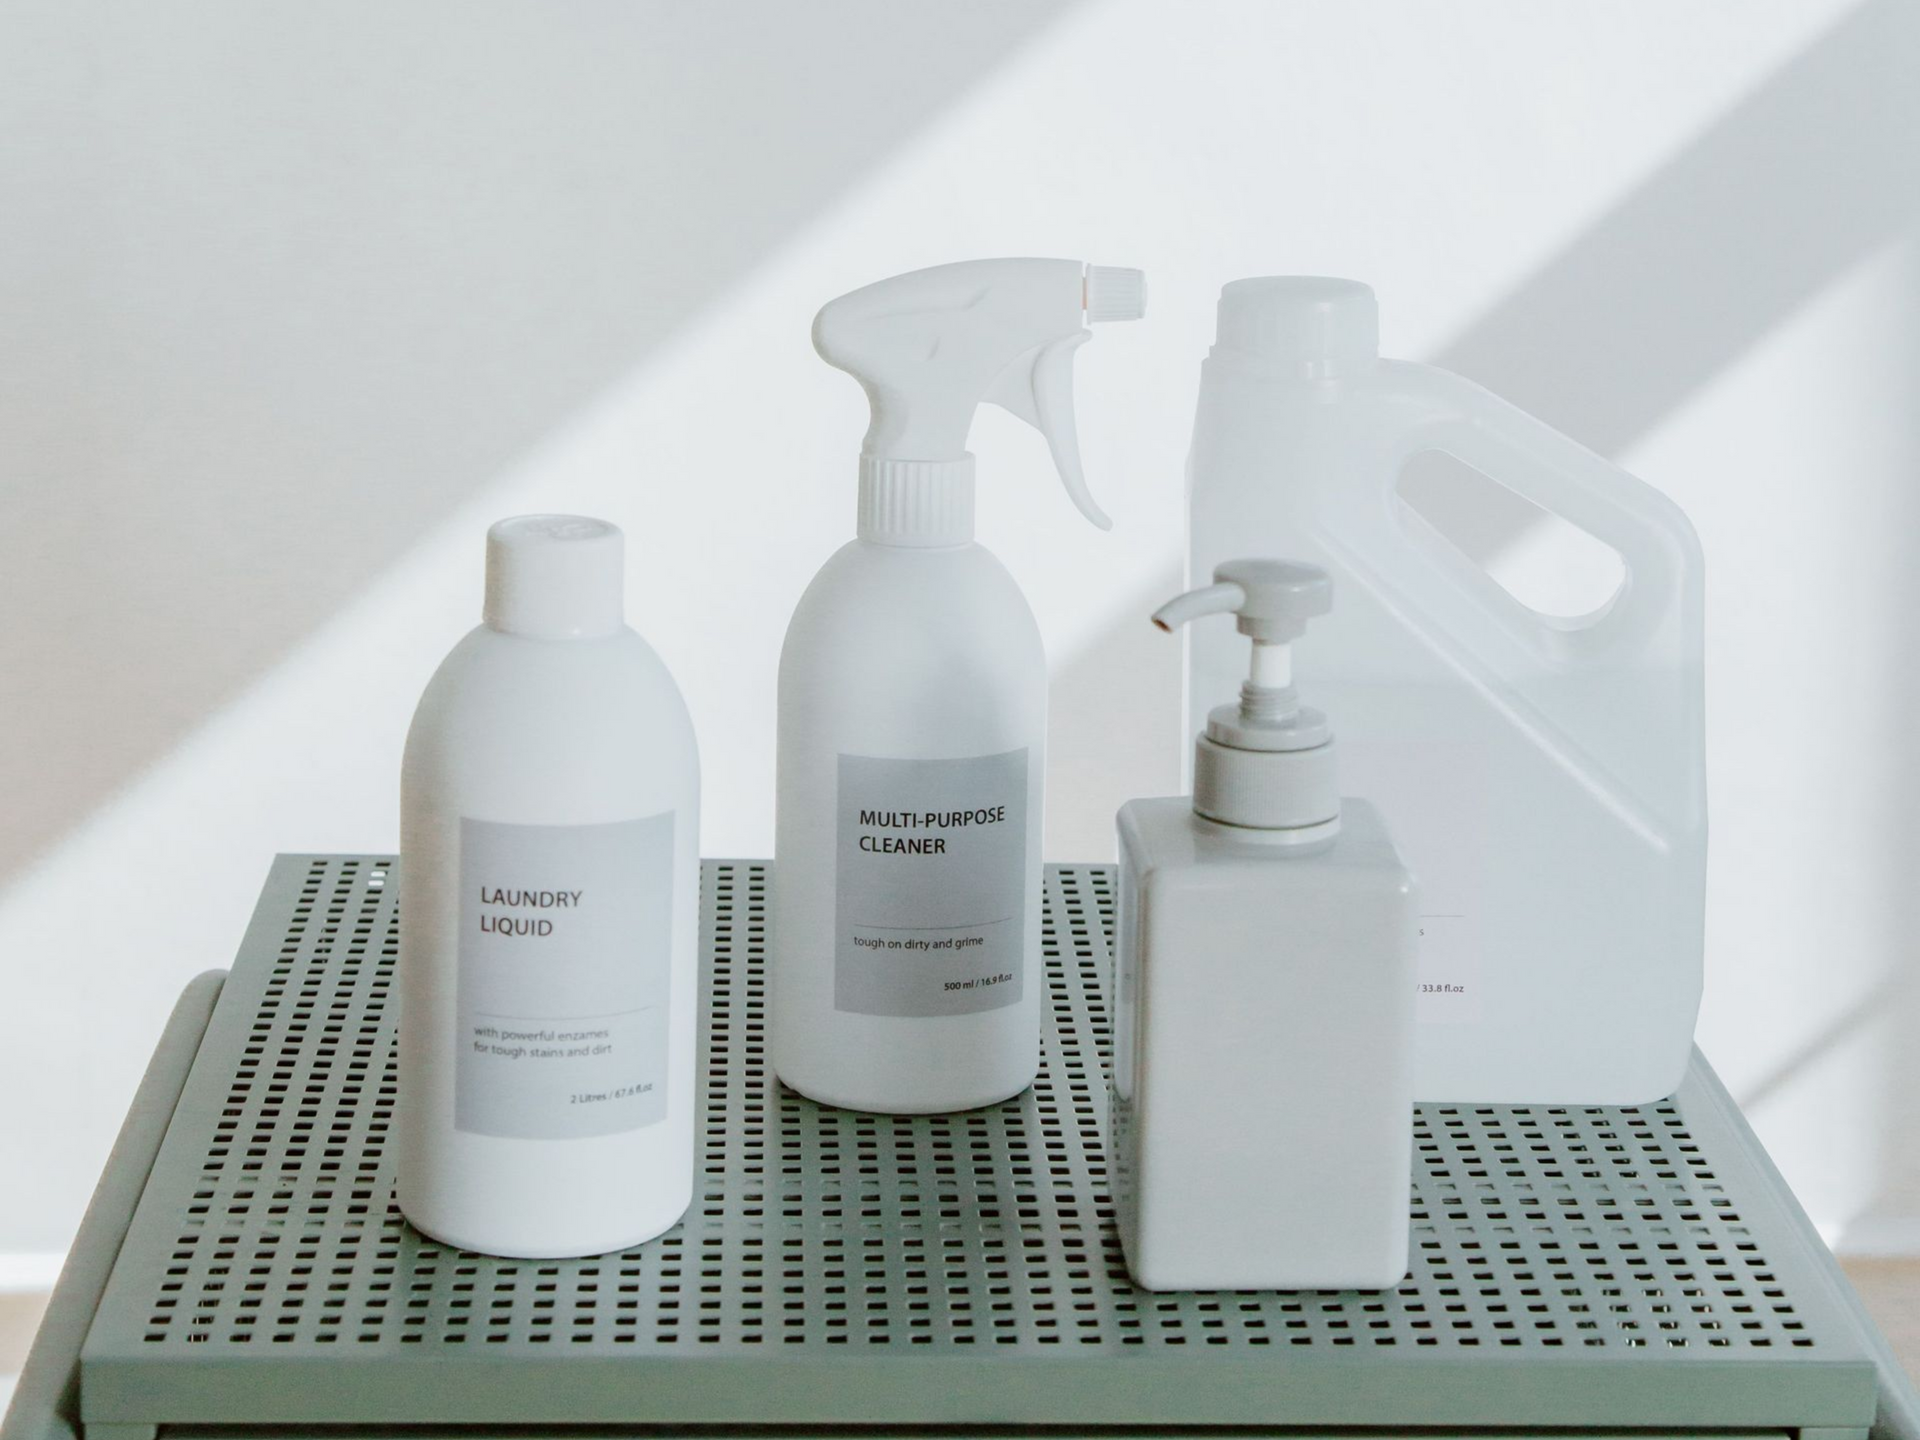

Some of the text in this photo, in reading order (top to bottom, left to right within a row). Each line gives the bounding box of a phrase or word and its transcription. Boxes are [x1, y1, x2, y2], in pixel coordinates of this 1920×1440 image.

[859, 806, 1005, 828] MULTI-PURPOSE
[859, 836, 946, 854] CLEANER
[481, 886, 583, 908] LAUNDRY
[480, 915, 553, 937] LIQUID
[854, 936, 984, 951] tough on dirty and grime
[943, 981, 962, 991] 500
[962, 979, 974, 989] ml
[981, 975, 998, 986] 16.9
[1422, 984, 1442, 993] 33.8
[1444, 984, 1464, 993] fl.oz
[474, 1027, 498, 1039] with
[501, 1030, 555, 1042] powerful
[474, 1040, 612, 1060] for tough stains and dirt
[570, 1094, 577, 1104] 2
[579, 1094, 607, 1104] Litres
